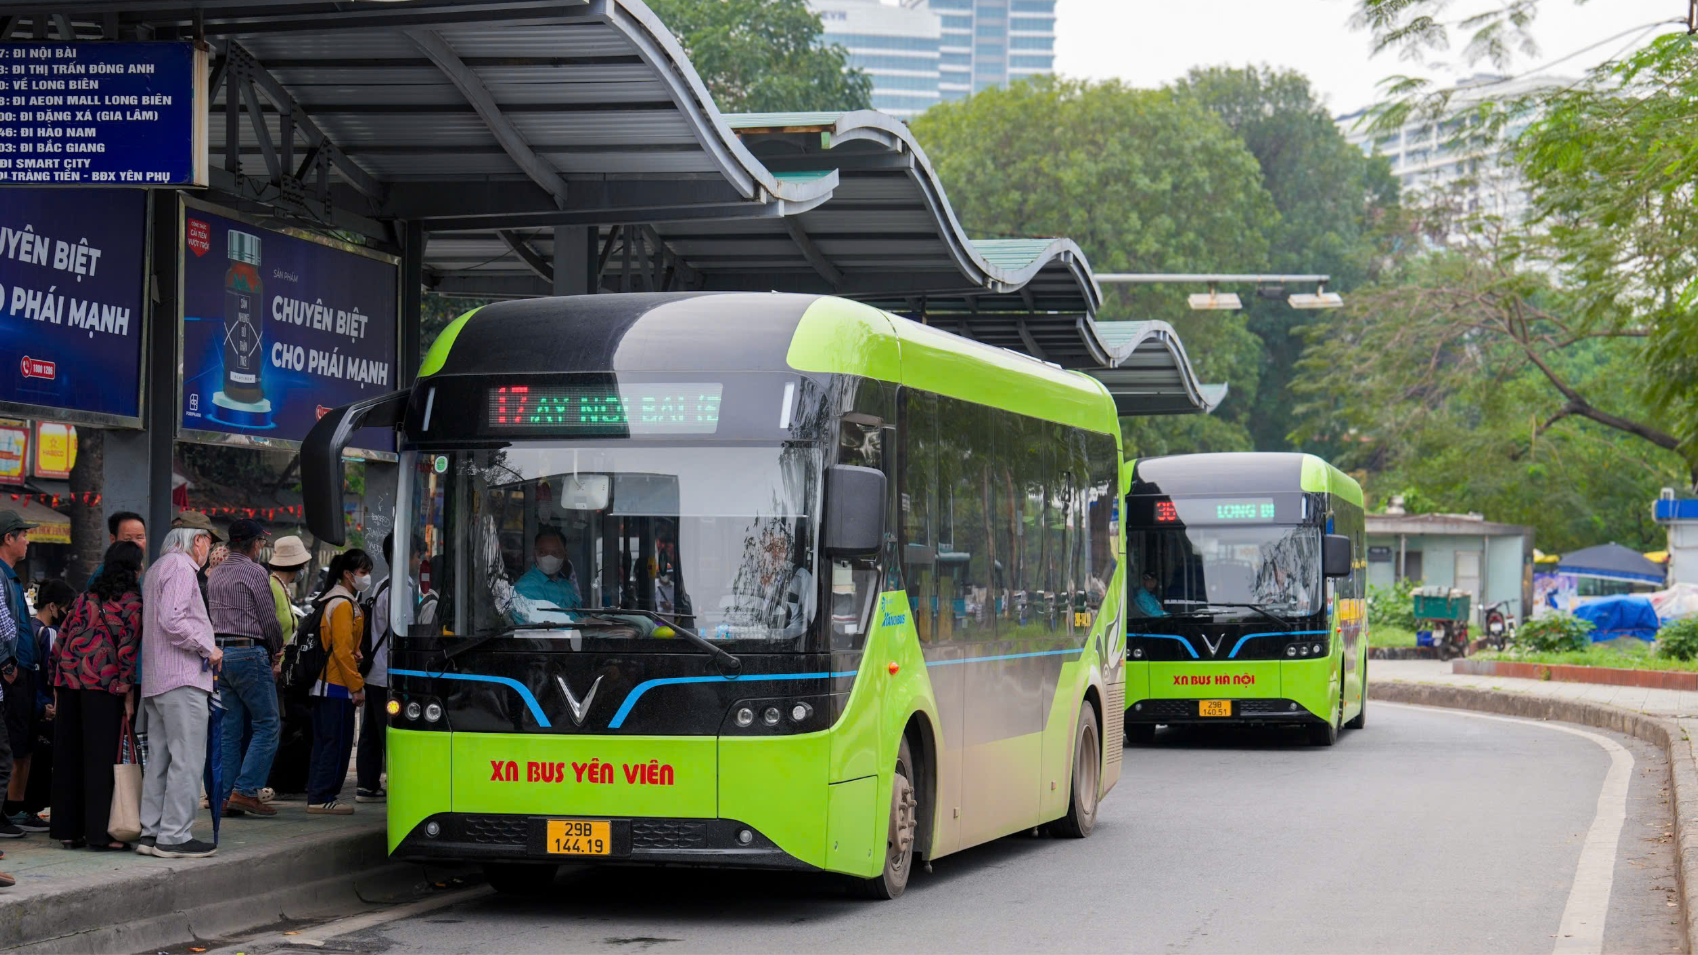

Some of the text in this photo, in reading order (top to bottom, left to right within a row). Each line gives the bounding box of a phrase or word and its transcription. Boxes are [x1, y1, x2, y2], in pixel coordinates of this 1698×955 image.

[13, 48, 26, 58] ĐI
[30, 46, 52, 60] NỘI
[55, 46, 77, 58] BÀI
[12, 64, 25, 74] ĐI
[29, 64, 48, 76] THỊ
[52, 61, 85, 74] TRẤN
[89, 62, 124, 74] ĐÔNG
[128, 64, 154, 74] ANH
[13, 77, 28, 90] VỀ
[32, 80, 65, 90] LONG
[69, 78, 99, 90] BIÊN
[13, 96, 26, 106] ĐI
[29, 95, 63, 106] AEON
[67, 95, 101, 105] MALL
[105, 95, 138, 105] LONG
[142, 93, 172, 105] BIÊN
[20, 111, 33, 121] ĐI
[36, 109, 71, 123] ĐẶNG
[75, 109, 92, 121] XÁ
[97, 111, 123, 122] (GIA
[126, 109, 159, 122] LÂM)
[20, 128, 33, 137] ĐI
[37, 124, 63, 137] HÀO
[66, 127, 96, 137] NAM
[20, 143, 33, 152] ĐI
[37, 139, 62, 152] BẮC
[66, 143, 105, 152] GIANG
[16, 158, 60, 168] SMART
[64, 158, 91, 168] CITY
[11, 169, 50, 181] TRÀNG
[53, 167, 80, 181] TIỀN
[92, 171, 116, 181] BĐX
[119, 169, 143, 181] YÊN
[146, 171, 170, 183] PHỤ
[53, 237, 101, 282] BIỆT
[10, 285, 65, 324] PHÁI
[67, 297, 130, 338] MẠNH
[272, 295, 369, 344] CHUYÊN BIỆT
[271, 341, 389, 389] CHO PHÁI MẠNH
[498, 386, 529, 423] 17
[1216, 504, 1256, 519] LONG
[1173, 671, 1255, 689] XN BUS HÀ NỘI
[1203, 708, 1227, 716] 140.51
[1208, 701, 1222, 709] 29B
[490, 757, 675, 786] XN BUS YÊN VIÊN
[564, 822, 592, 837] 29B
[555, 838, 604, 853] 144.19
